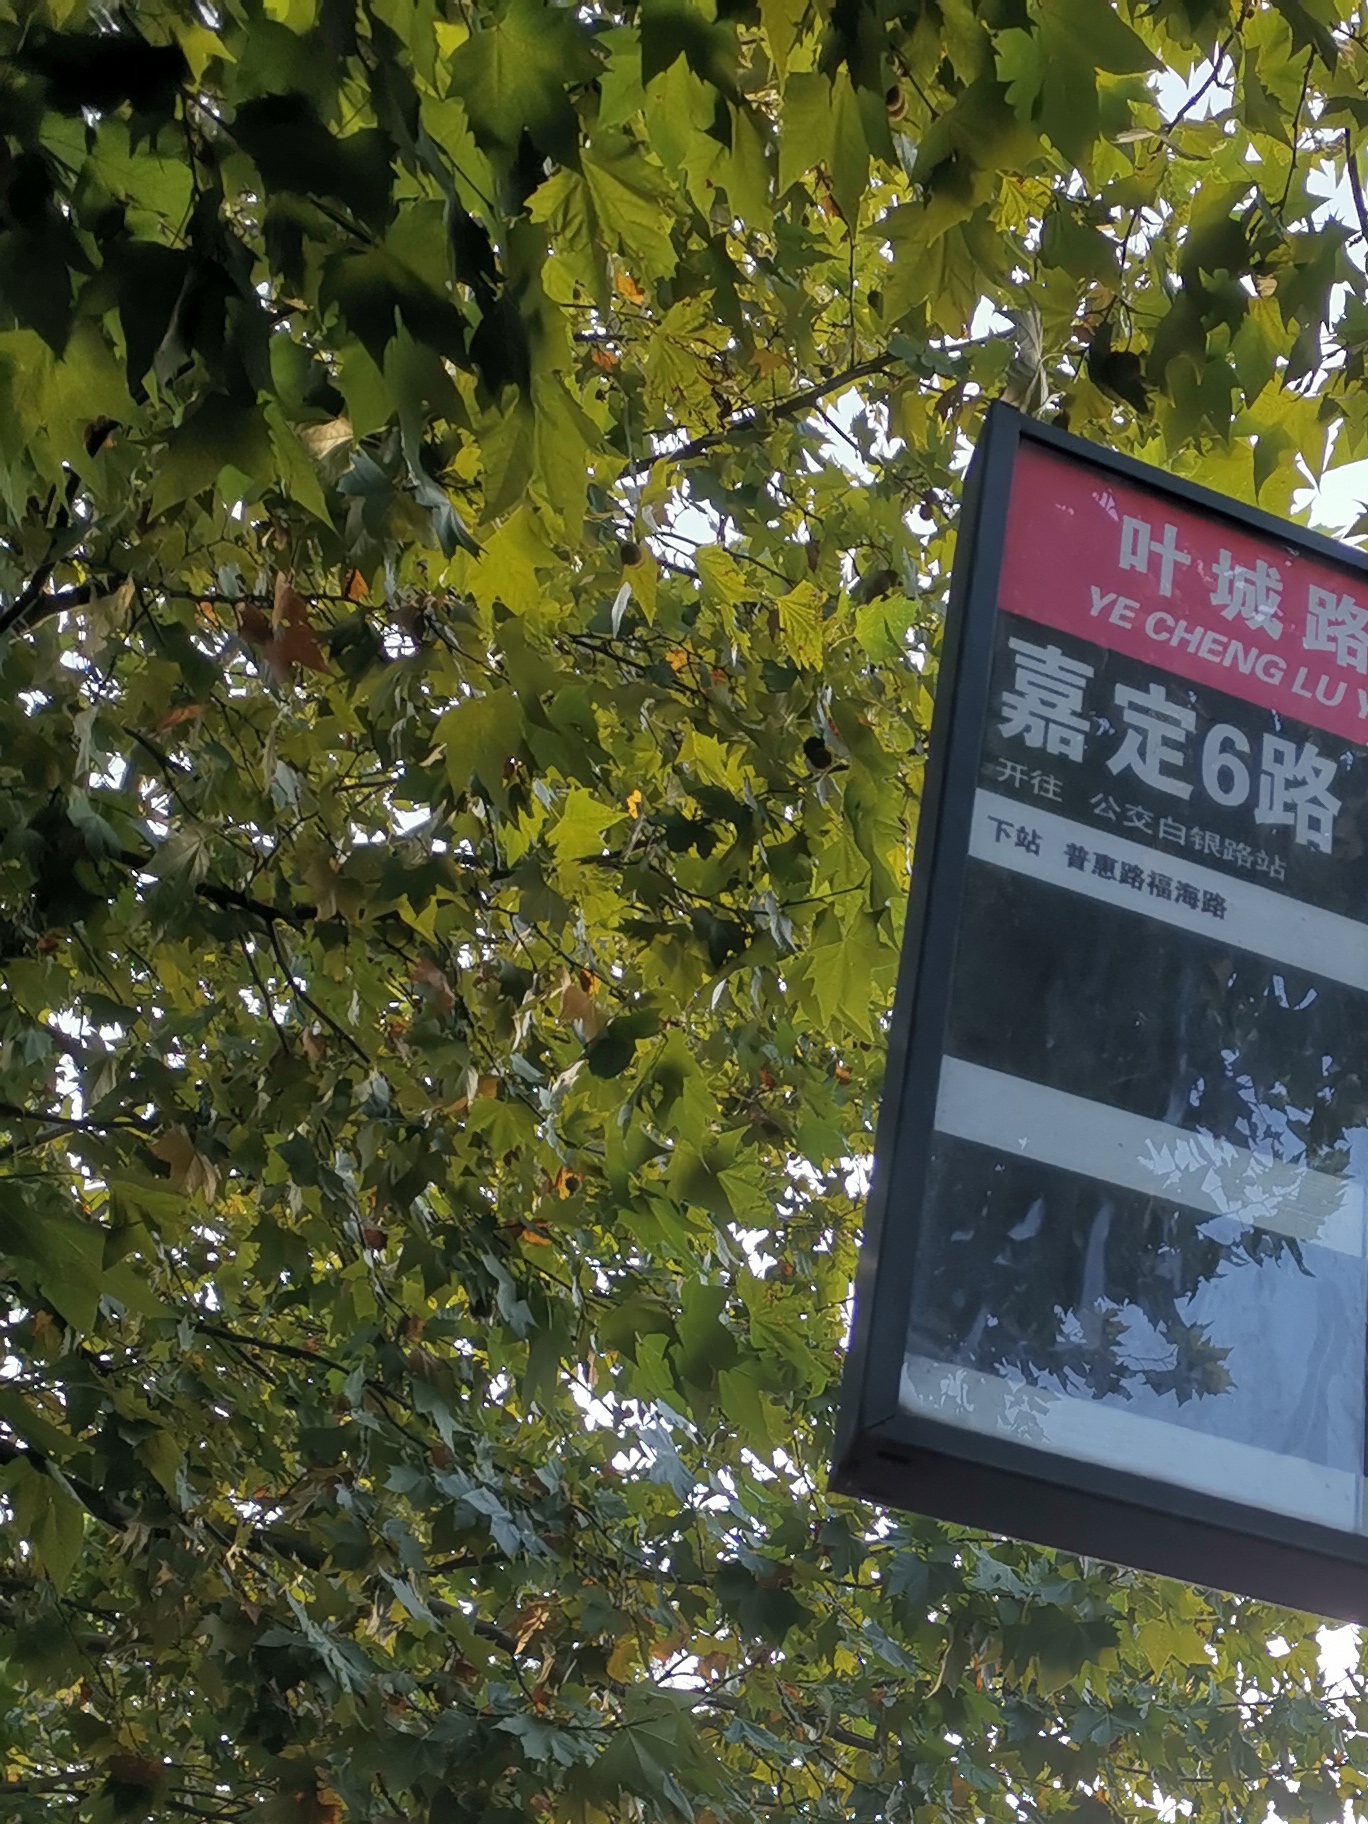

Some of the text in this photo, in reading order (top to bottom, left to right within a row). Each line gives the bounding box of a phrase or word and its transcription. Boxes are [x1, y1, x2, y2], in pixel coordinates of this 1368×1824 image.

[1088, 586, 1135, 631] YE
[1144, 608, 1285, 686] CHENG
[1290, 671, 1347, 709] LU
[999, 636, 1343, 855] 嘉定6路
[987, 815, 1229, 920] 下站 普惠路福海路
[995, 757, 1288, 881] 开往 公交白银路站
